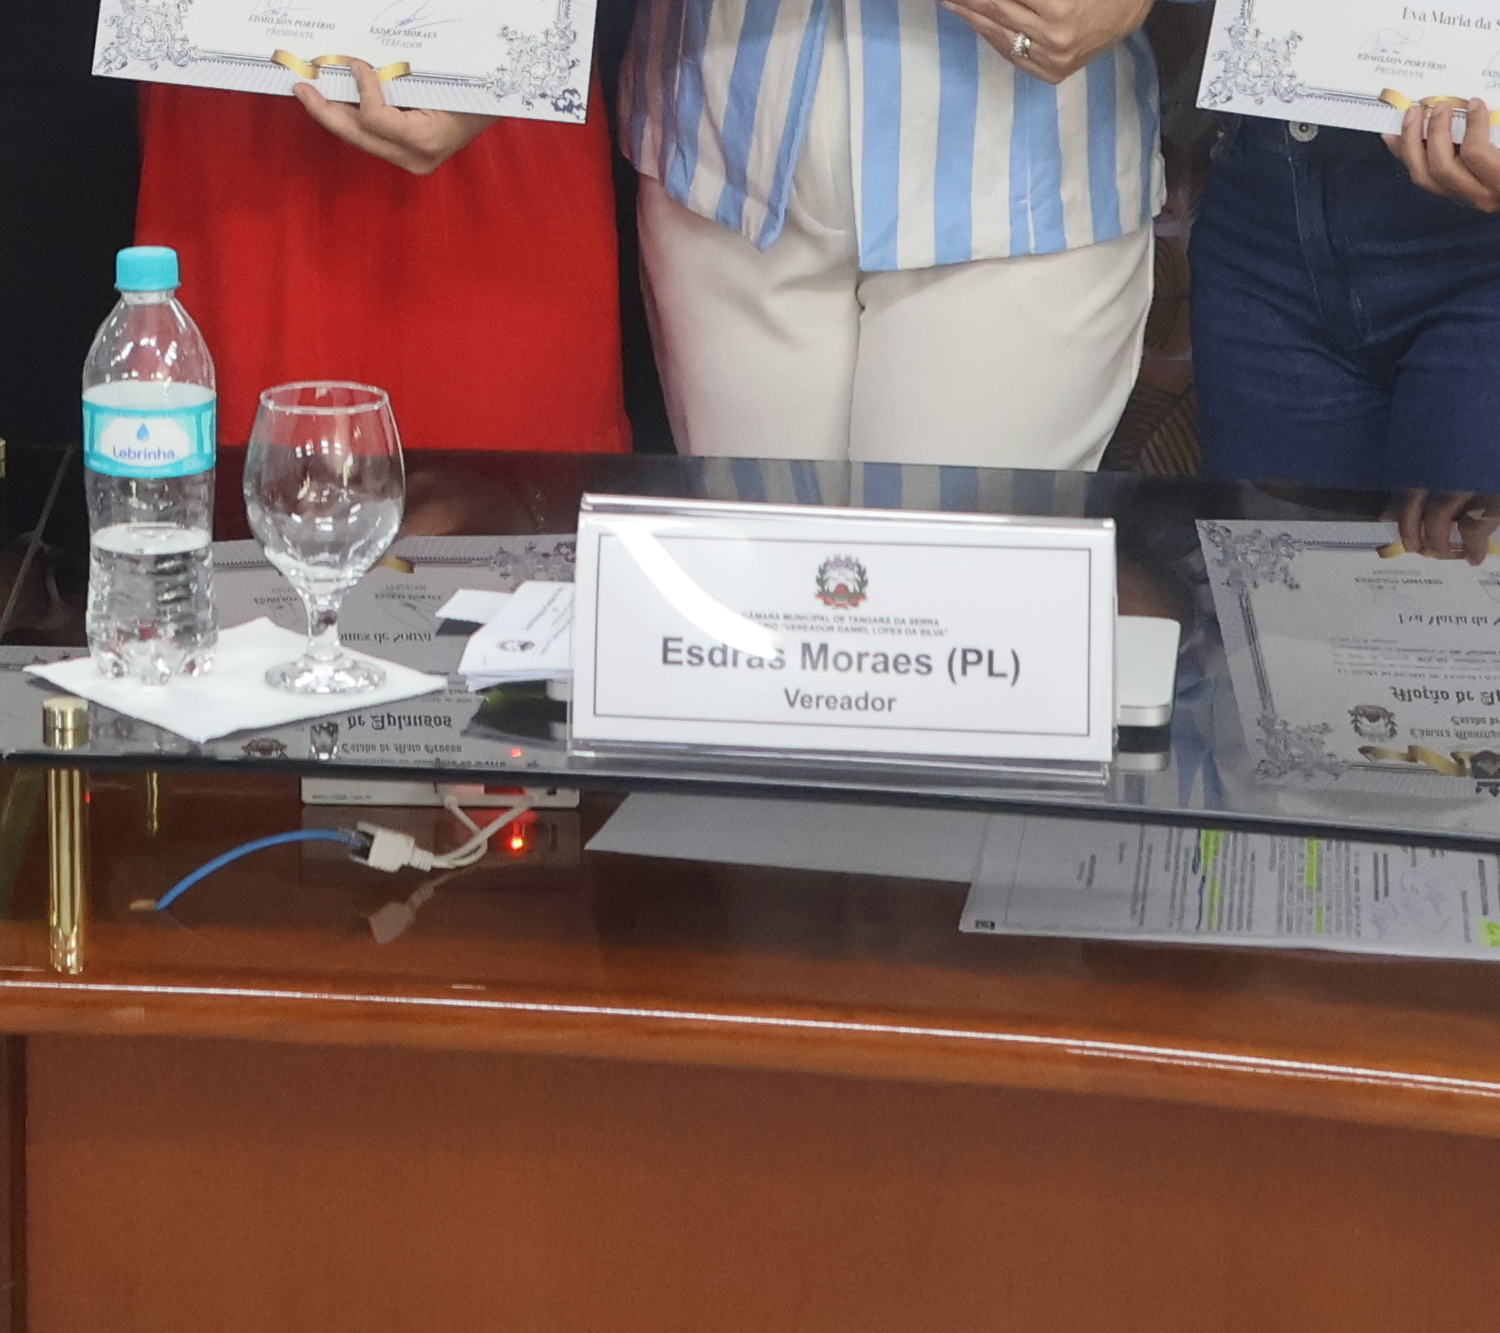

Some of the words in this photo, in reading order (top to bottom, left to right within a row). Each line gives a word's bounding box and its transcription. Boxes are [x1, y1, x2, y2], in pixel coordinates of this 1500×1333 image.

[1403, 7, 1426, 21] Eva
[1431, 11, 1470, 27] Maria
[1475, 17, 1491, 30] da
[801, 641, 933, 677] Moraes
[947, 646, 1021, 686] (PL)
[784, 688, 897, 713] Vereador
